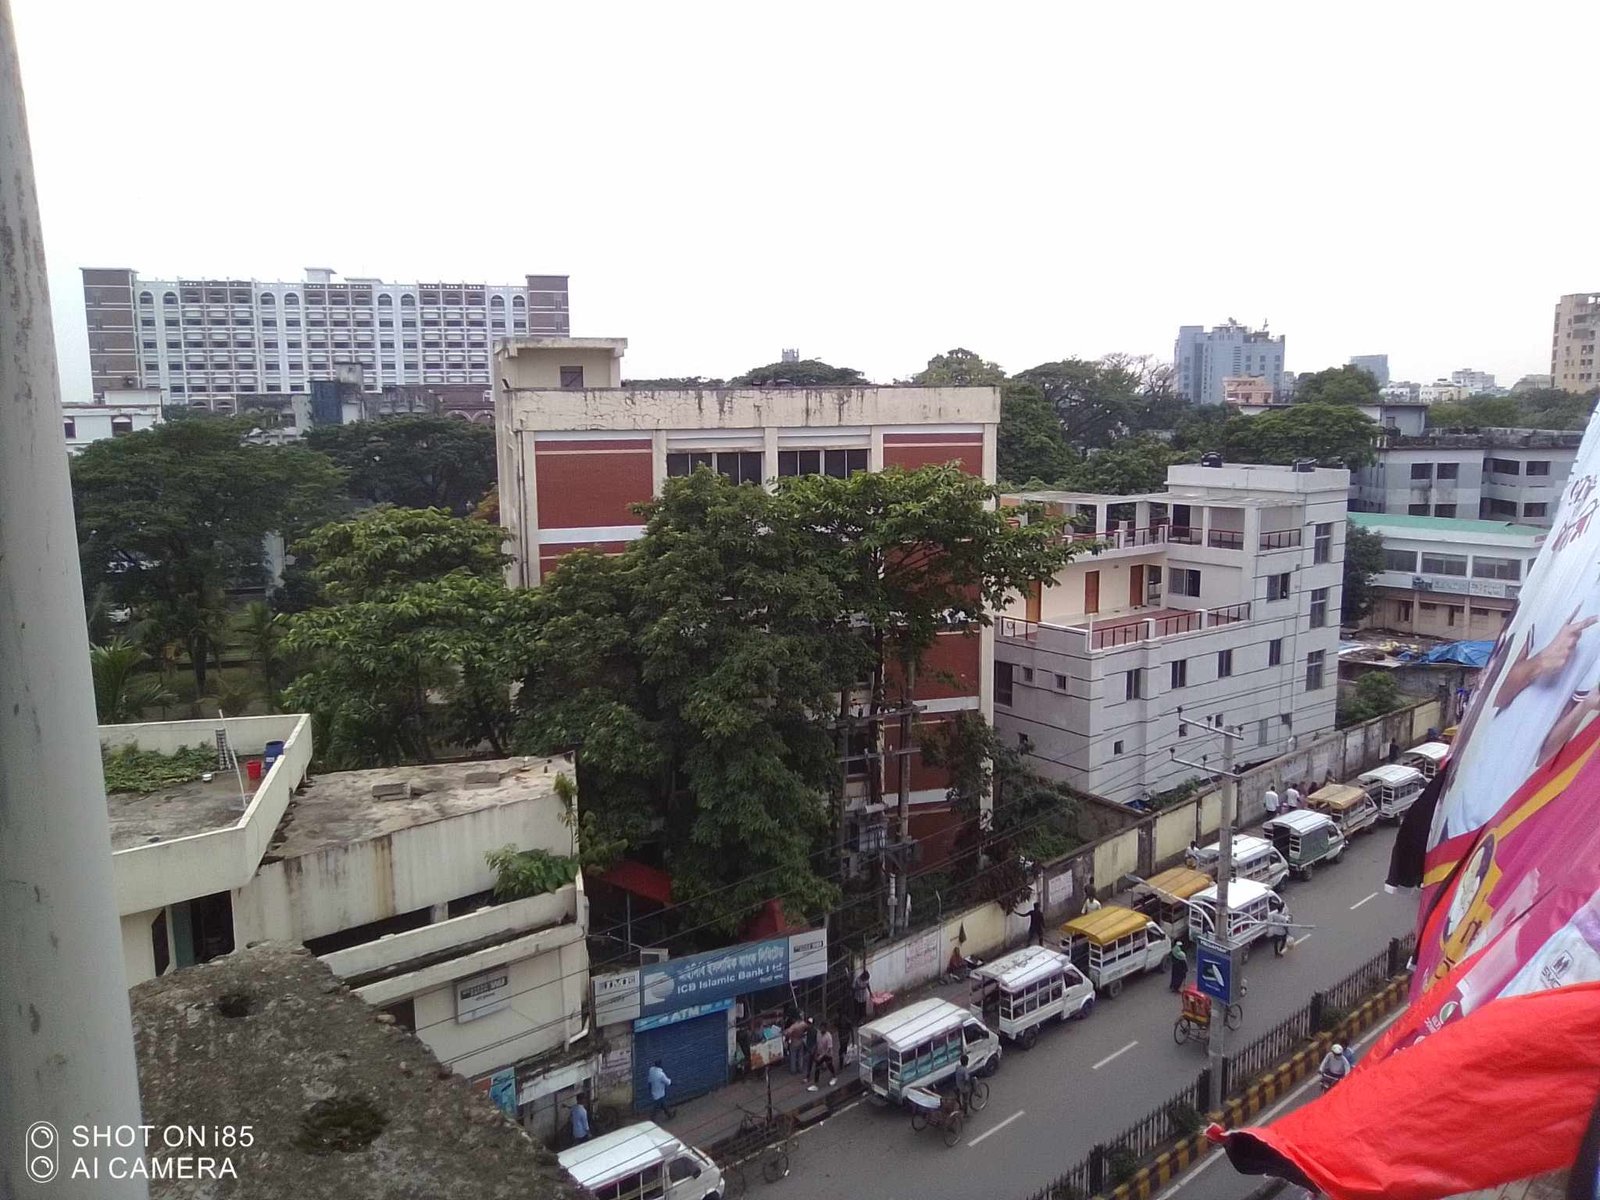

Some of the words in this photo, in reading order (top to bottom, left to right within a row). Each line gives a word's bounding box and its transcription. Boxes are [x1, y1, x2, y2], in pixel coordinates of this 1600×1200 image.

[677, 982, 696, 994] ICB
[699, 975, 736, 989] Islamic
[738, 967, 764, 980] Bank
[671, 1005, 700, 1022] ATM
